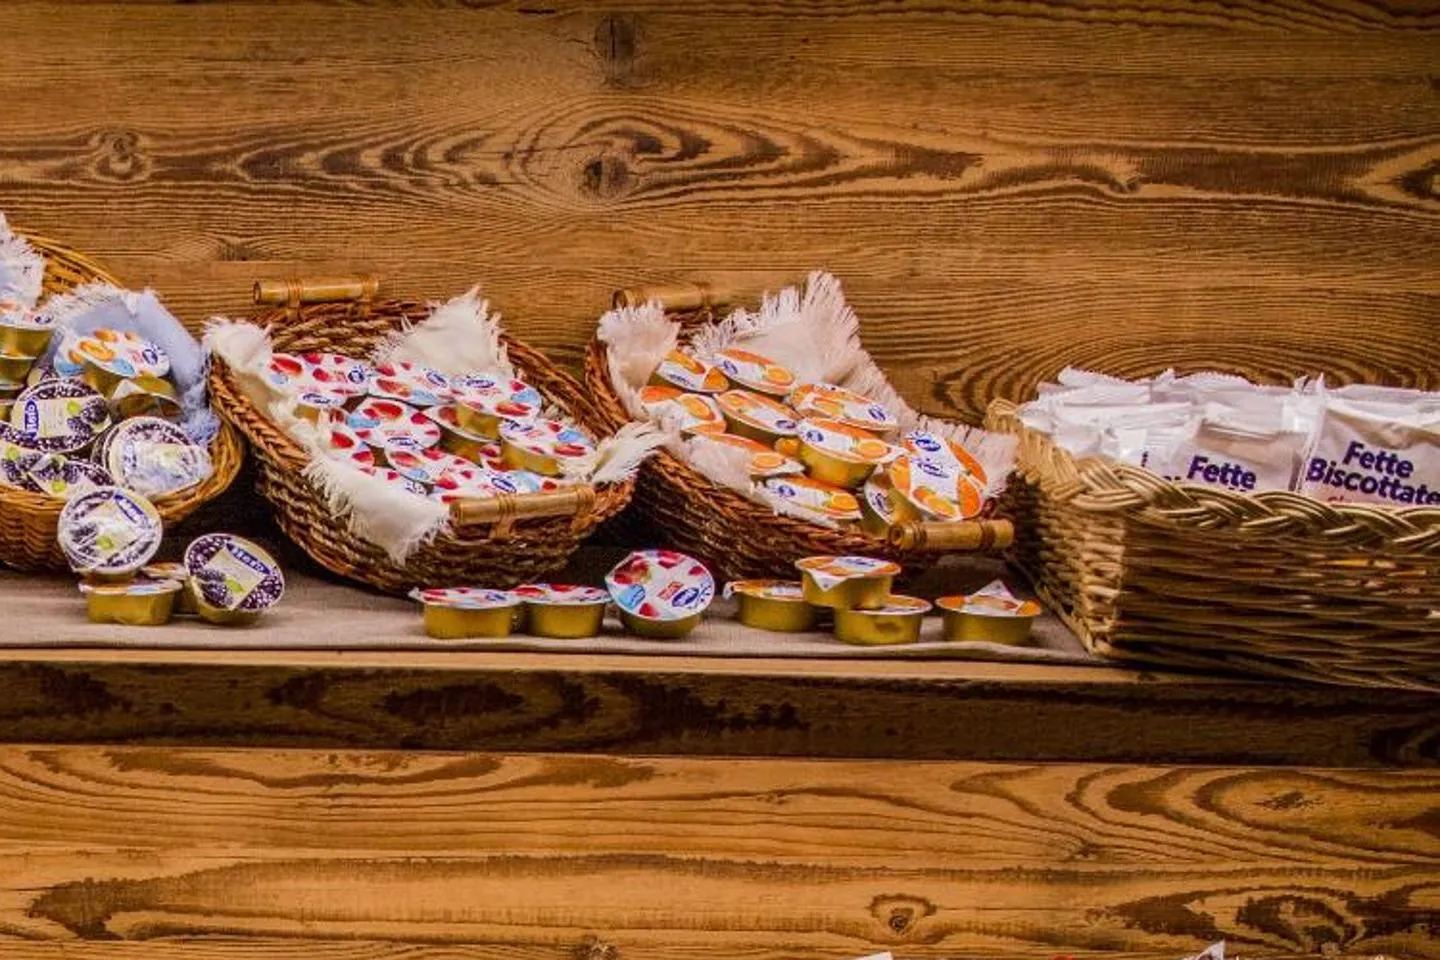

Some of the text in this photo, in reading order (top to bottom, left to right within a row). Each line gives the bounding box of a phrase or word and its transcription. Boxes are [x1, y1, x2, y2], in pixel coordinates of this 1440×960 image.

[1186, 454, 1257, 490] Fette
[1342, 441, 1414, 479] Fette
[1305, 457, 1440, 505] Biscottate
